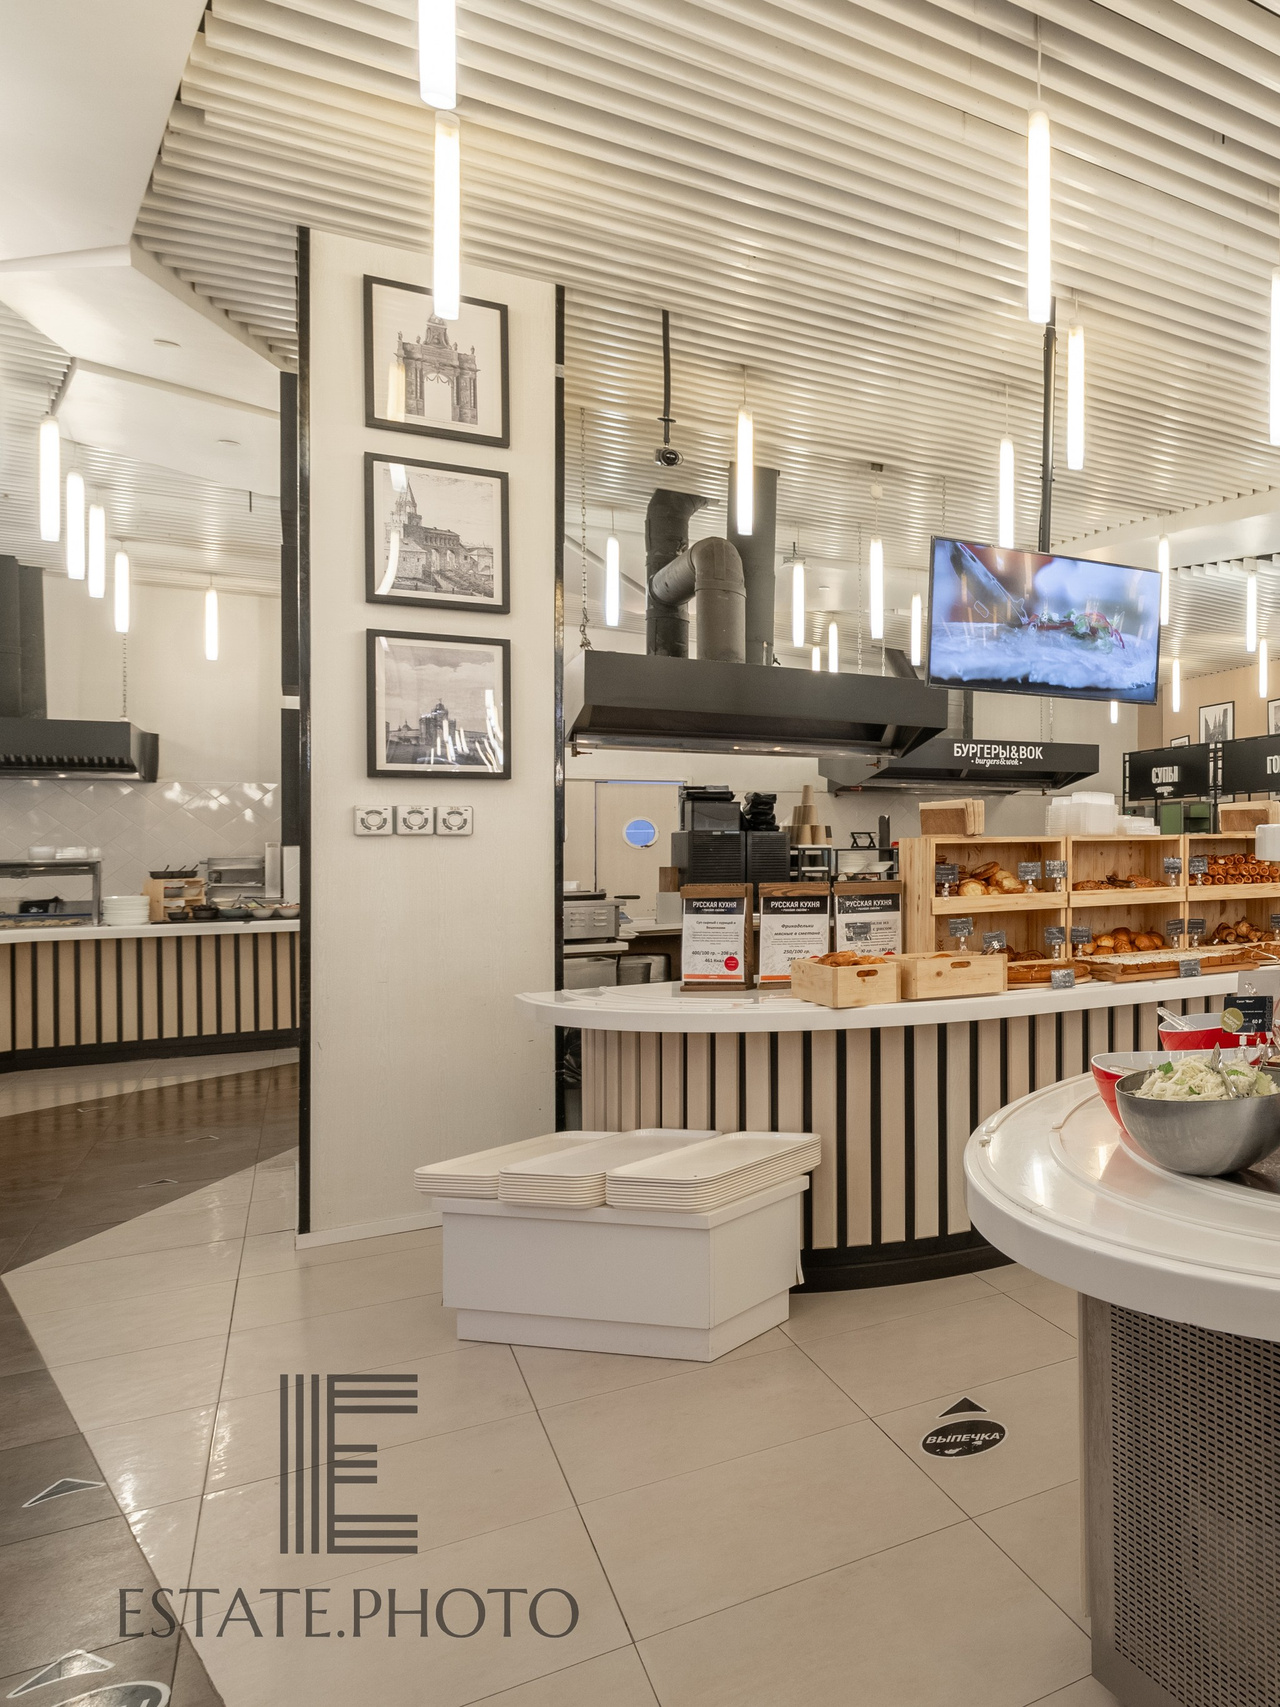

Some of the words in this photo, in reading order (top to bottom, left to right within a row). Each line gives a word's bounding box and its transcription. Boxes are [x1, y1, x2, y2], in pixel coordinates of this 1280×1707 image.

[953, 743, 1043, 759] БУРГЕРЫ&ВОК
[1151, 766, 1179, 784] СУПЫ
[926, 1432, 1000, 1444] ВЫПЕЧКА
